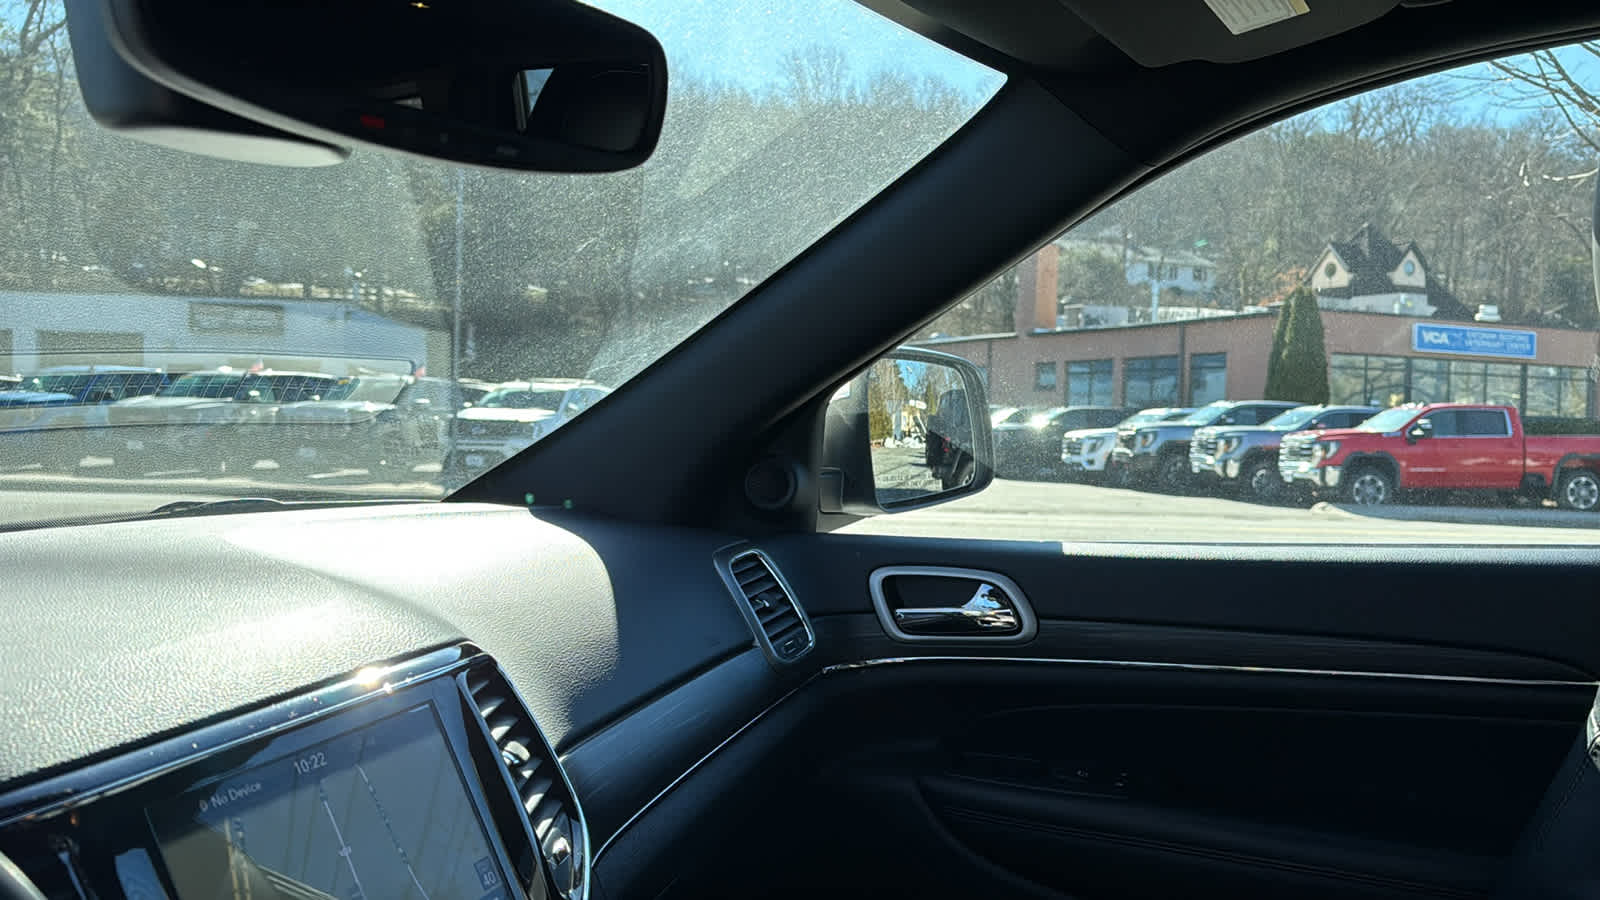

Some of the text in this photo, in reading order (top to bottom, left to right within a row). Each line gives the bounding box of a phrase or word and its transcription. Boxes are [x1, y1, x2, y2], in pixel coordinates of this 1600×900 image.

[1422, 330, 1449, 345] VCA
[294, 752, 327, 774] 10:22
[210, 782, 262, 808] No Device
